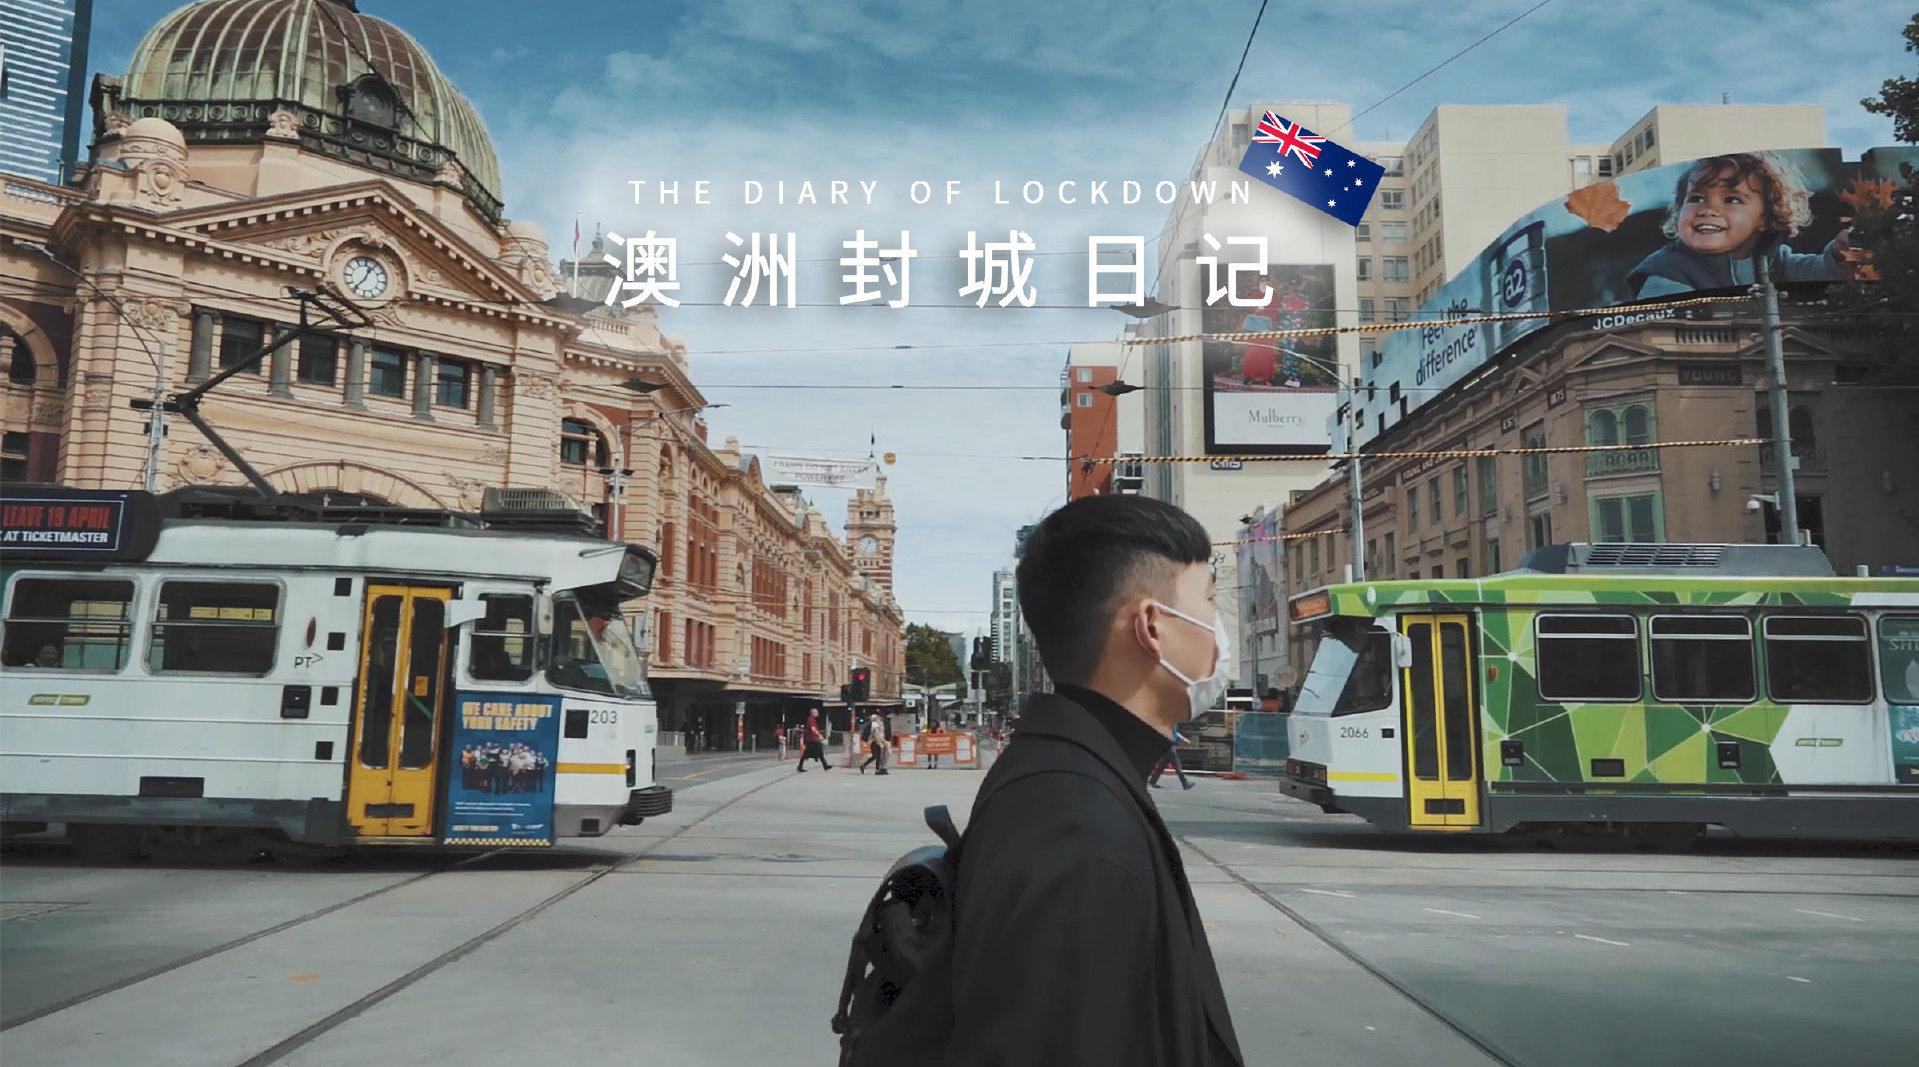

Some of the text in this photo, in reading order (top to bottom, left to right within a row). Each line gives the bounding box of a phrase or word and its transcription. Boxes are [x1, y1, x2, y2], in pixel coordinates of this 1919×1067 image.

[1505, 268, 1525, 299] a2
[1592, 308, 1676, 331] JCDecaux
[1416, 327, 1477, 386] difference
[1247, 407, 1303, 426] Mulberry
[2, 506, 44, 527] LEAVE
[68, 507, 110, 528] APRIL
[3, 531, 20, 541] AT
[22, 531, 108, 543] TICKETMASTER
[590, 710, 618, 724] 203
[1340, 726, 1369, 739] 2066
